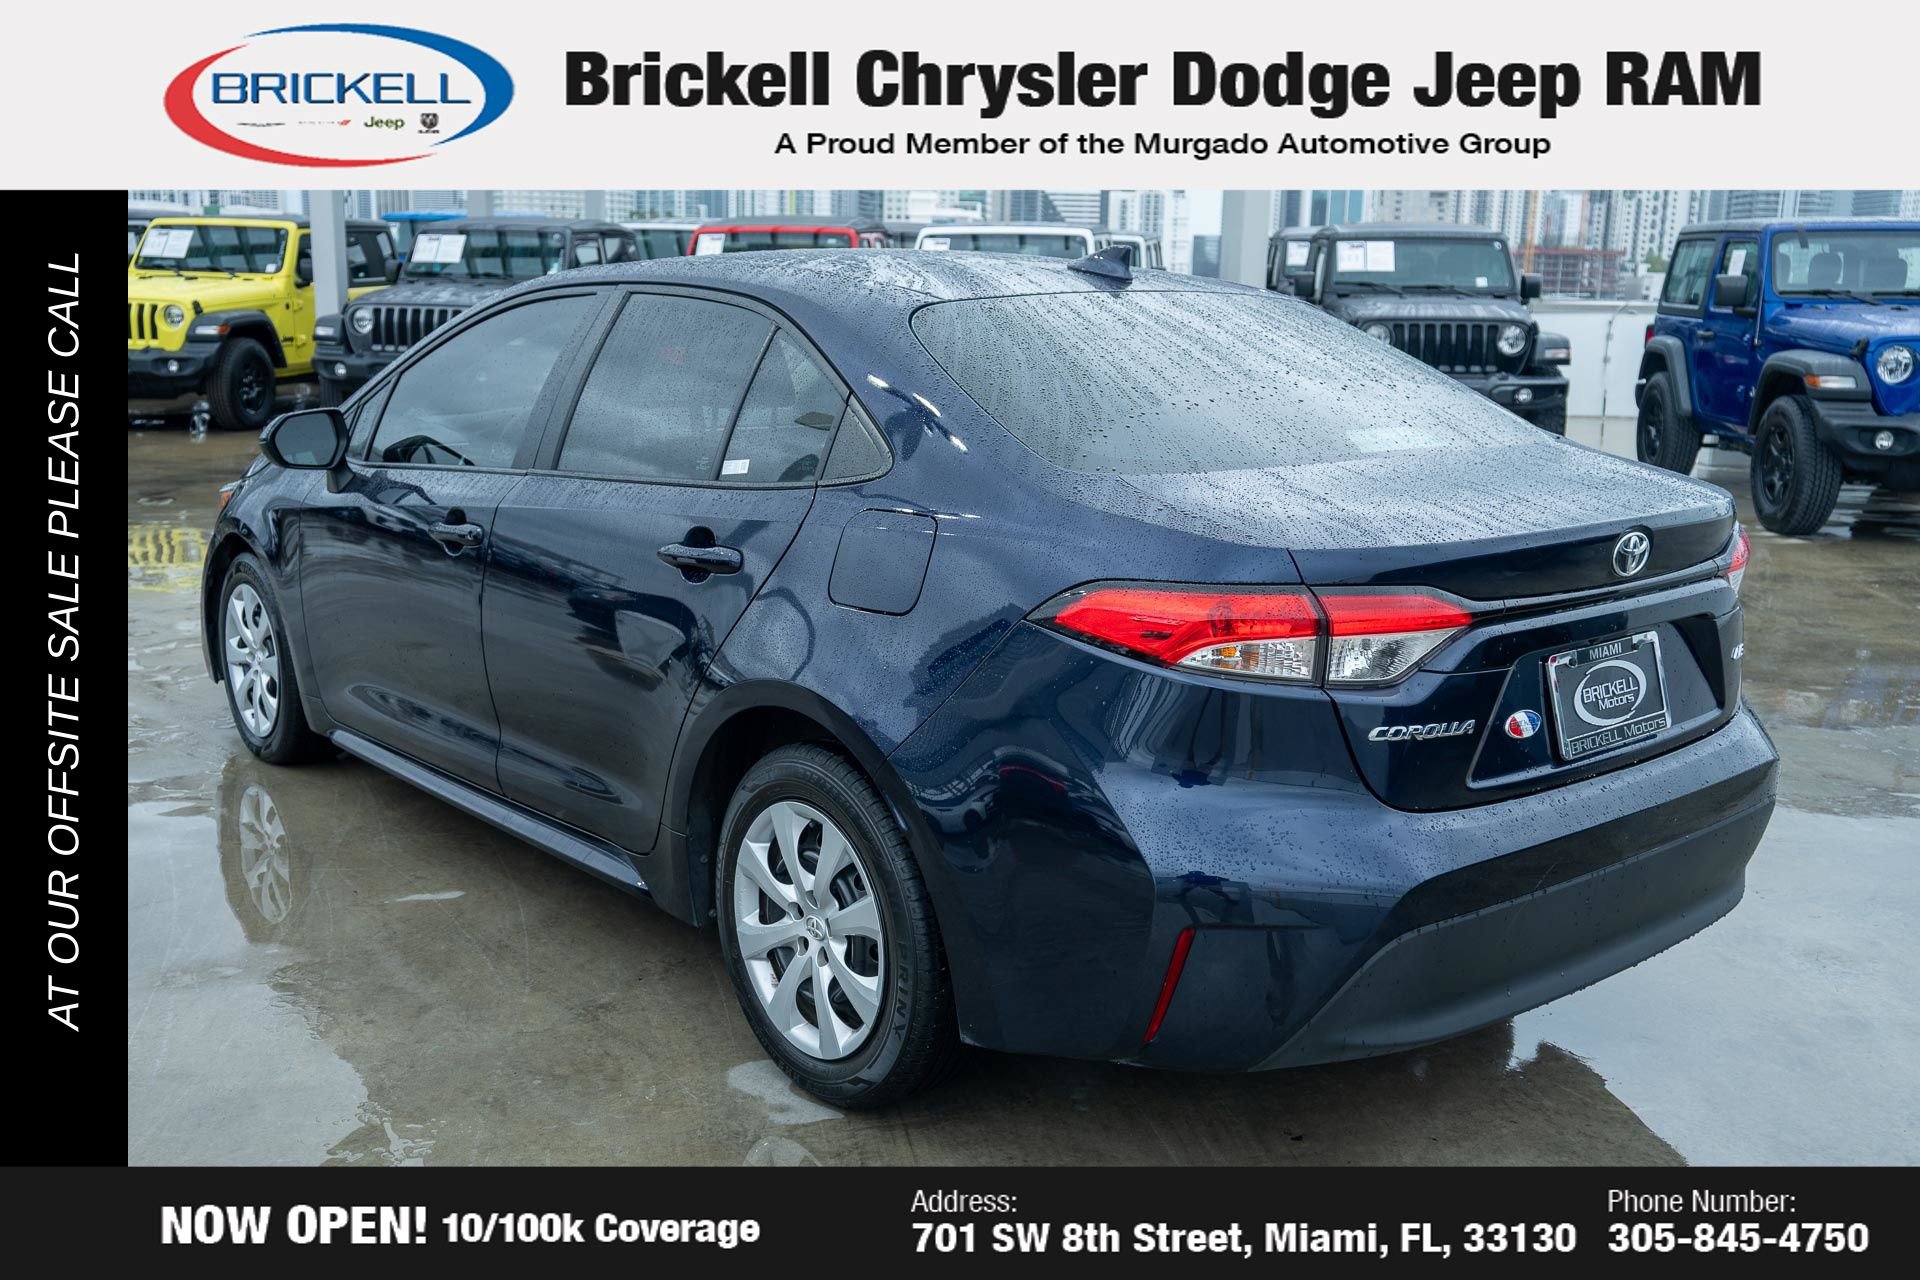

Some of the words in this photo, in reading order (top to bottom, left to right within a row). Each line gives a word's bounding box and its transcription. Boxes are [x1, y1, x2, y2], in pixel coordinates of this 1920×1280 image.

[1589, 642, 1622, 661] MIAMI
[1582, 677, 1639, 704] BRICKELL
[1598, 693, 1635, 711] Motors
[1367, 719, 1476, 742] COROLLA
[1571, 729, 1623, 754] BRICKELL
[1623, 717, 1666, 738] Motors
